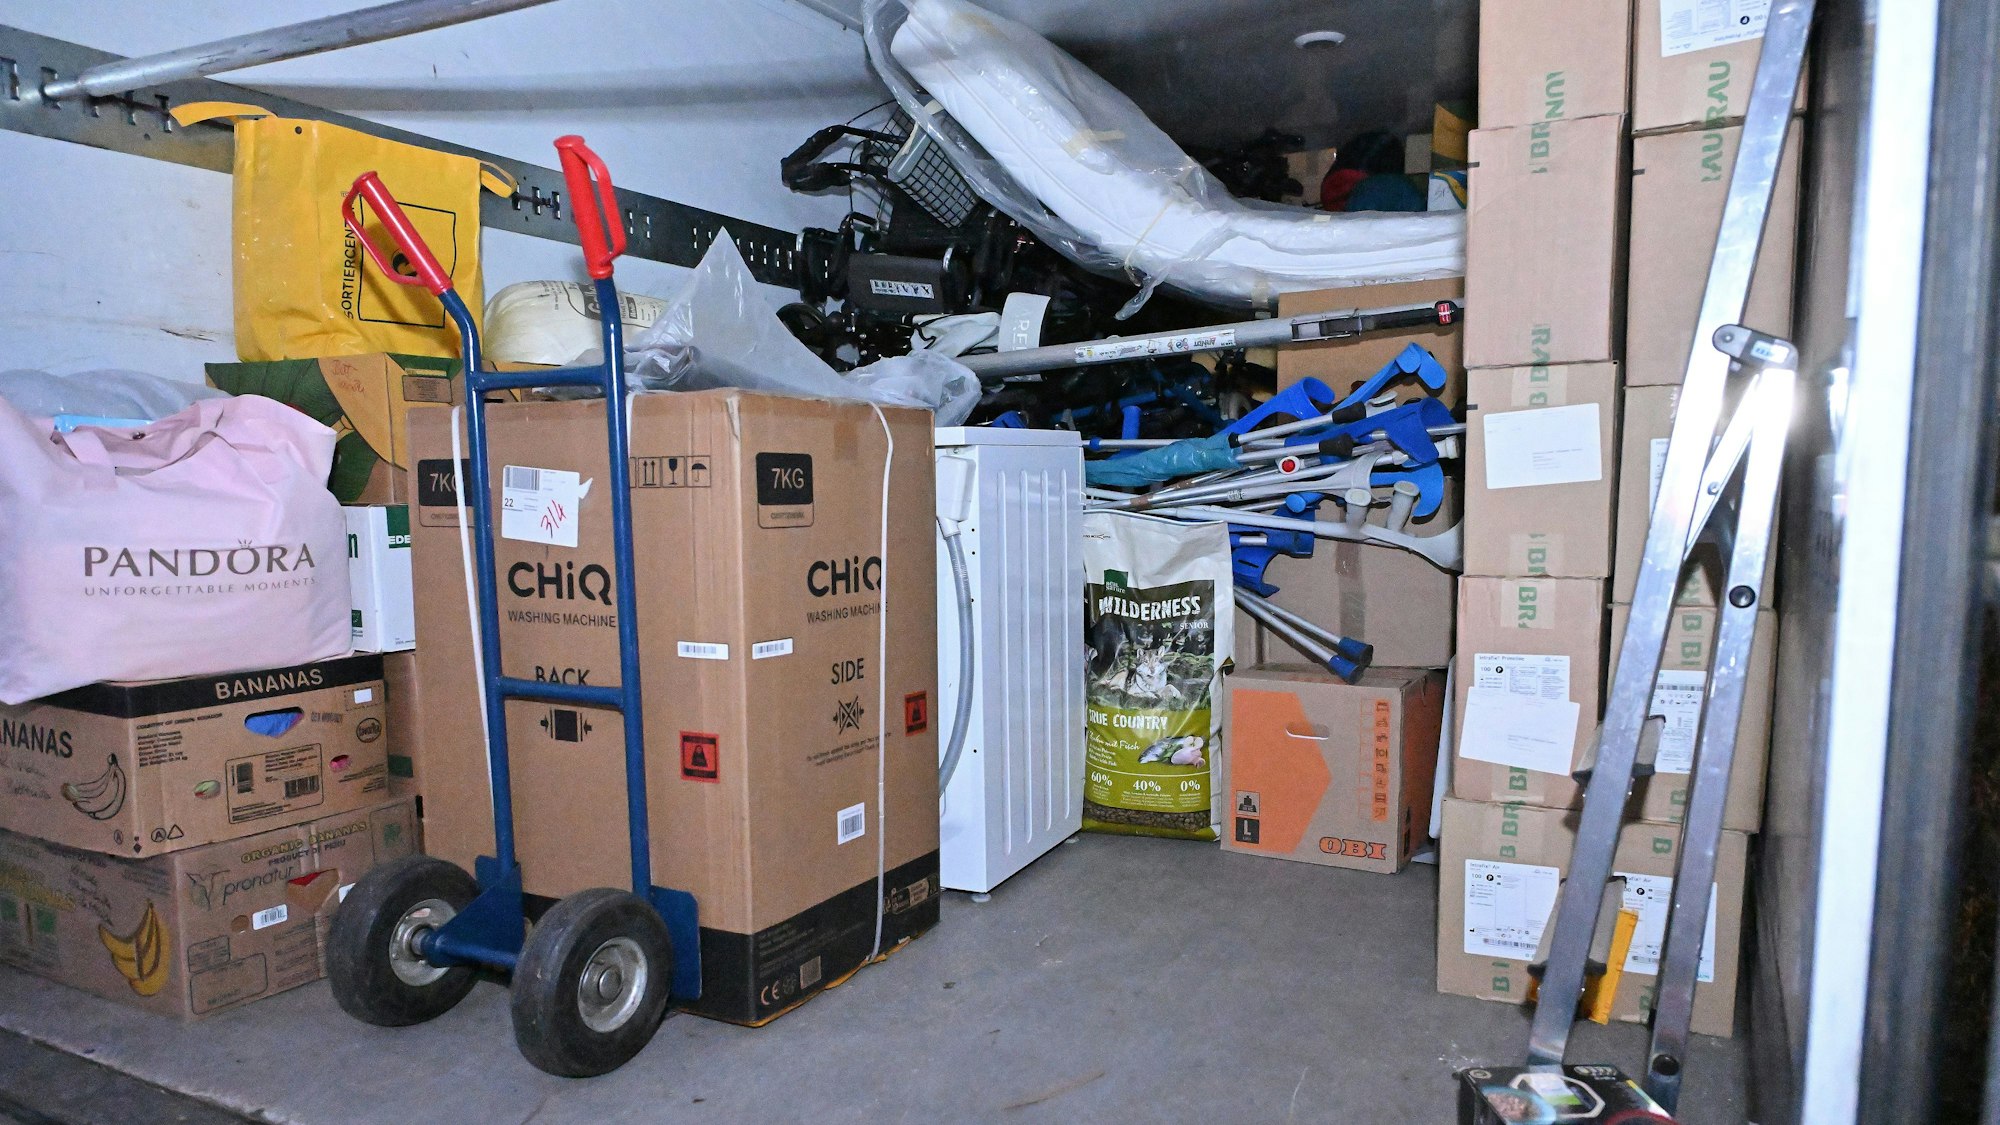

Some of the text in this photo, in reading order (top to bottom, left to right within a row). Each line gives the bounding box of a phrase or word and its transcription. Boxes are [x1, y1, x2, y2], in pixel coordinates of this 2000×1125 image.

[771, 468, 804, 489] 7KG
[504, 498, 514, 508] 22
[84, 539, 316, 577] PANDORA
[85, 577, 316, 598] UNFORGETTABLE MOMENTS
[507, 561, 612, 605] CHiQ
[807, 607, 848, 624] WASHING
[1099, 595, 1201, 621] WILDERNESS
[508, 610, 617, 628] WASHING MACHINE
[1179, 621, 1209, 630] SENIOR
[831, 660, 866, 686] SIDE
[215, 670, 323, 700] BANANAS
[1113, 713, 1168, 730] COUNTRY
[0, 718, 73, 759] NANAS
[1119, 739, 1140, 750] Fisch
[1091, 771, 1113, 786] 60%
[1132, 780, 1161, 792] 40%
[1180, 780, 1201, 791] 0%
[1243, 820, 1252, 835] L
[241, 821, 367, 865] ORGANIC BANANAS
[1319, 837, 1387, 861] OBI
[269, 849, 309, 865] PRODUCT
[223, 866, 293, 905] pronatur
